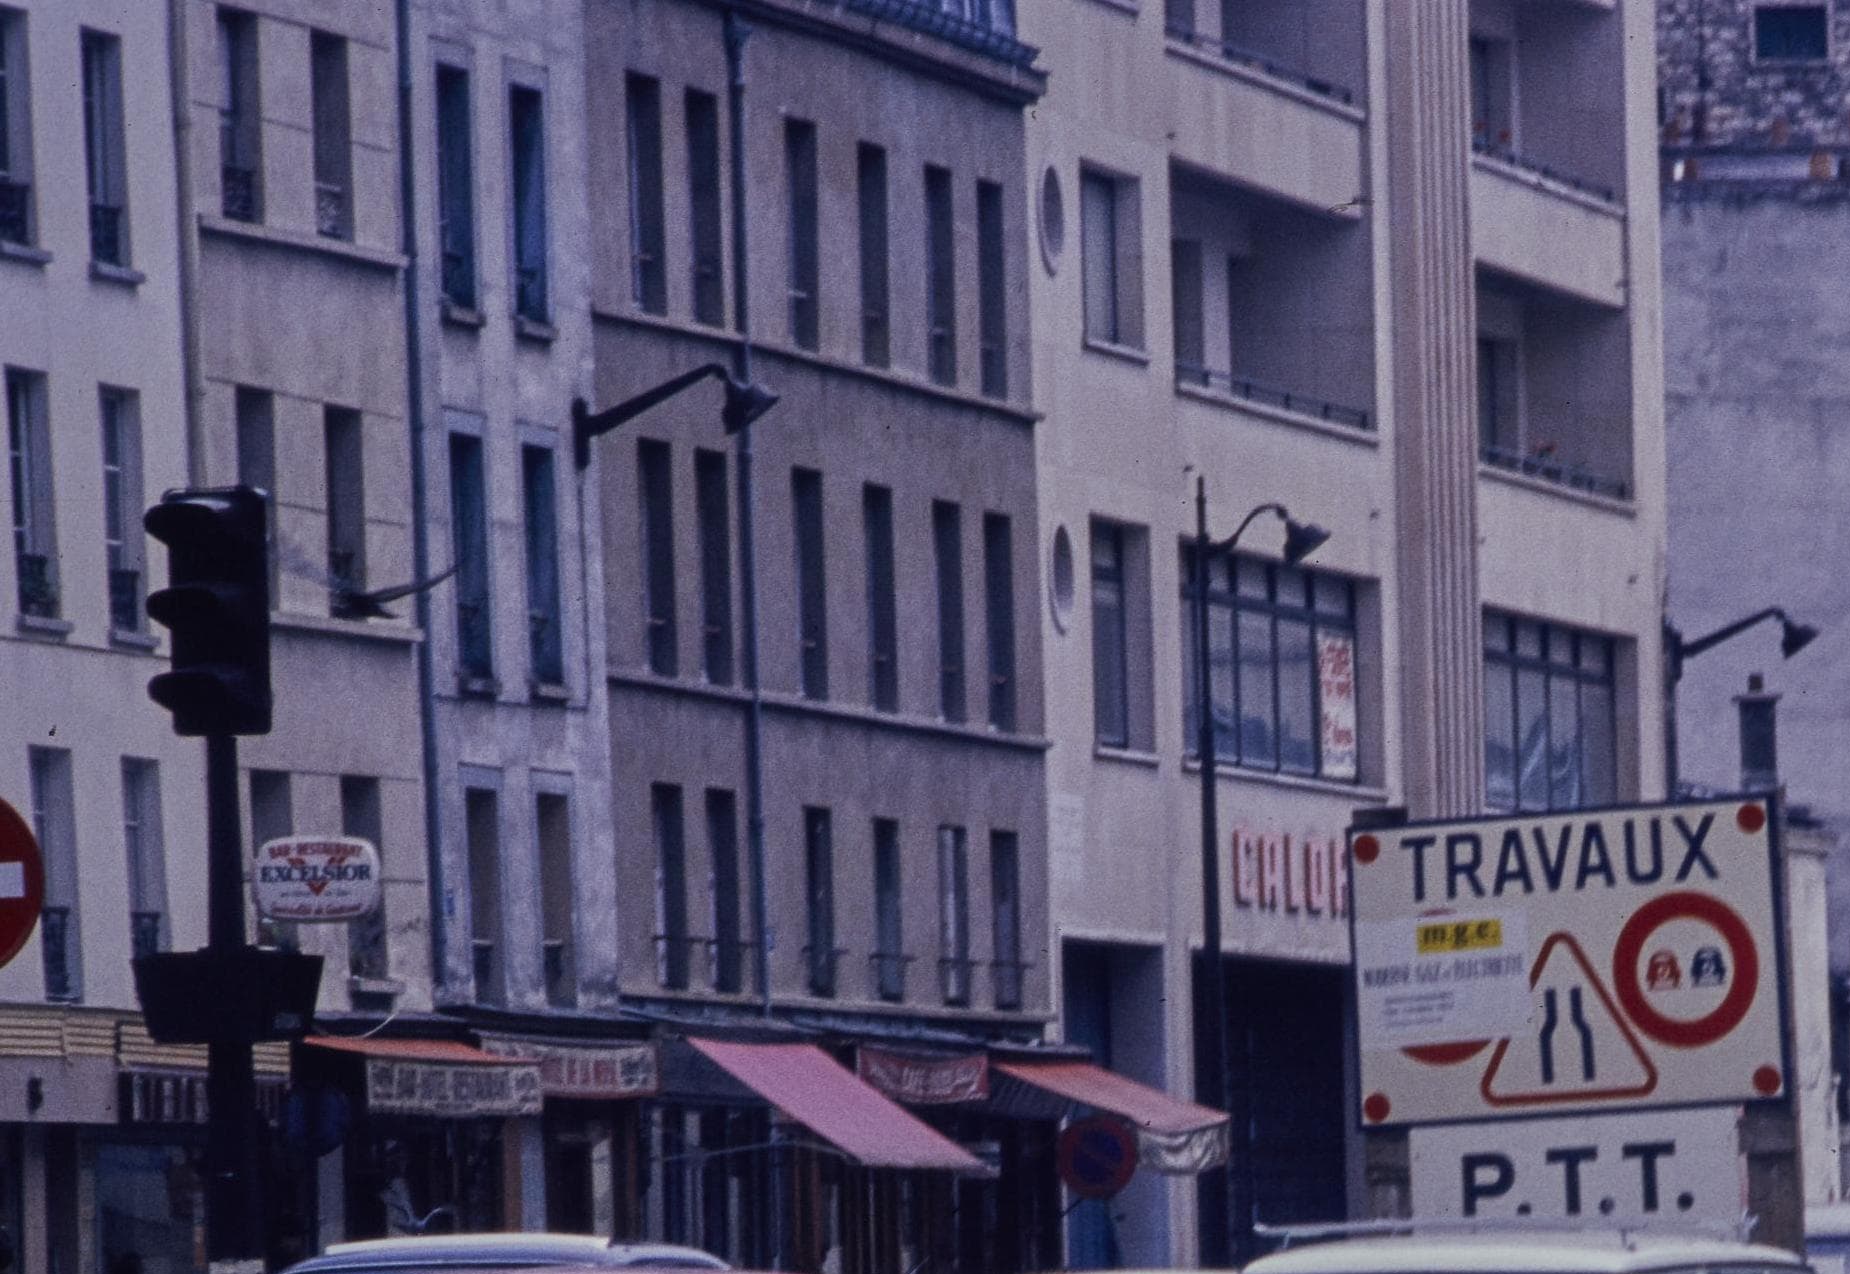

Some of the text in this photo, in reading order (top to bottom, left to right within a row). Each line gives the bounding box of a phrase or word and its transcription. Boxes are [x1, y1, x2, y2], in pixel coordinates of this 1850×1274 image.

[261, 864, 370, 882] EXCELSIOR
[1401, 813, 1718, 902] TRAVAUX
[1461, 1140, 1694, 1217] P.T.T.
